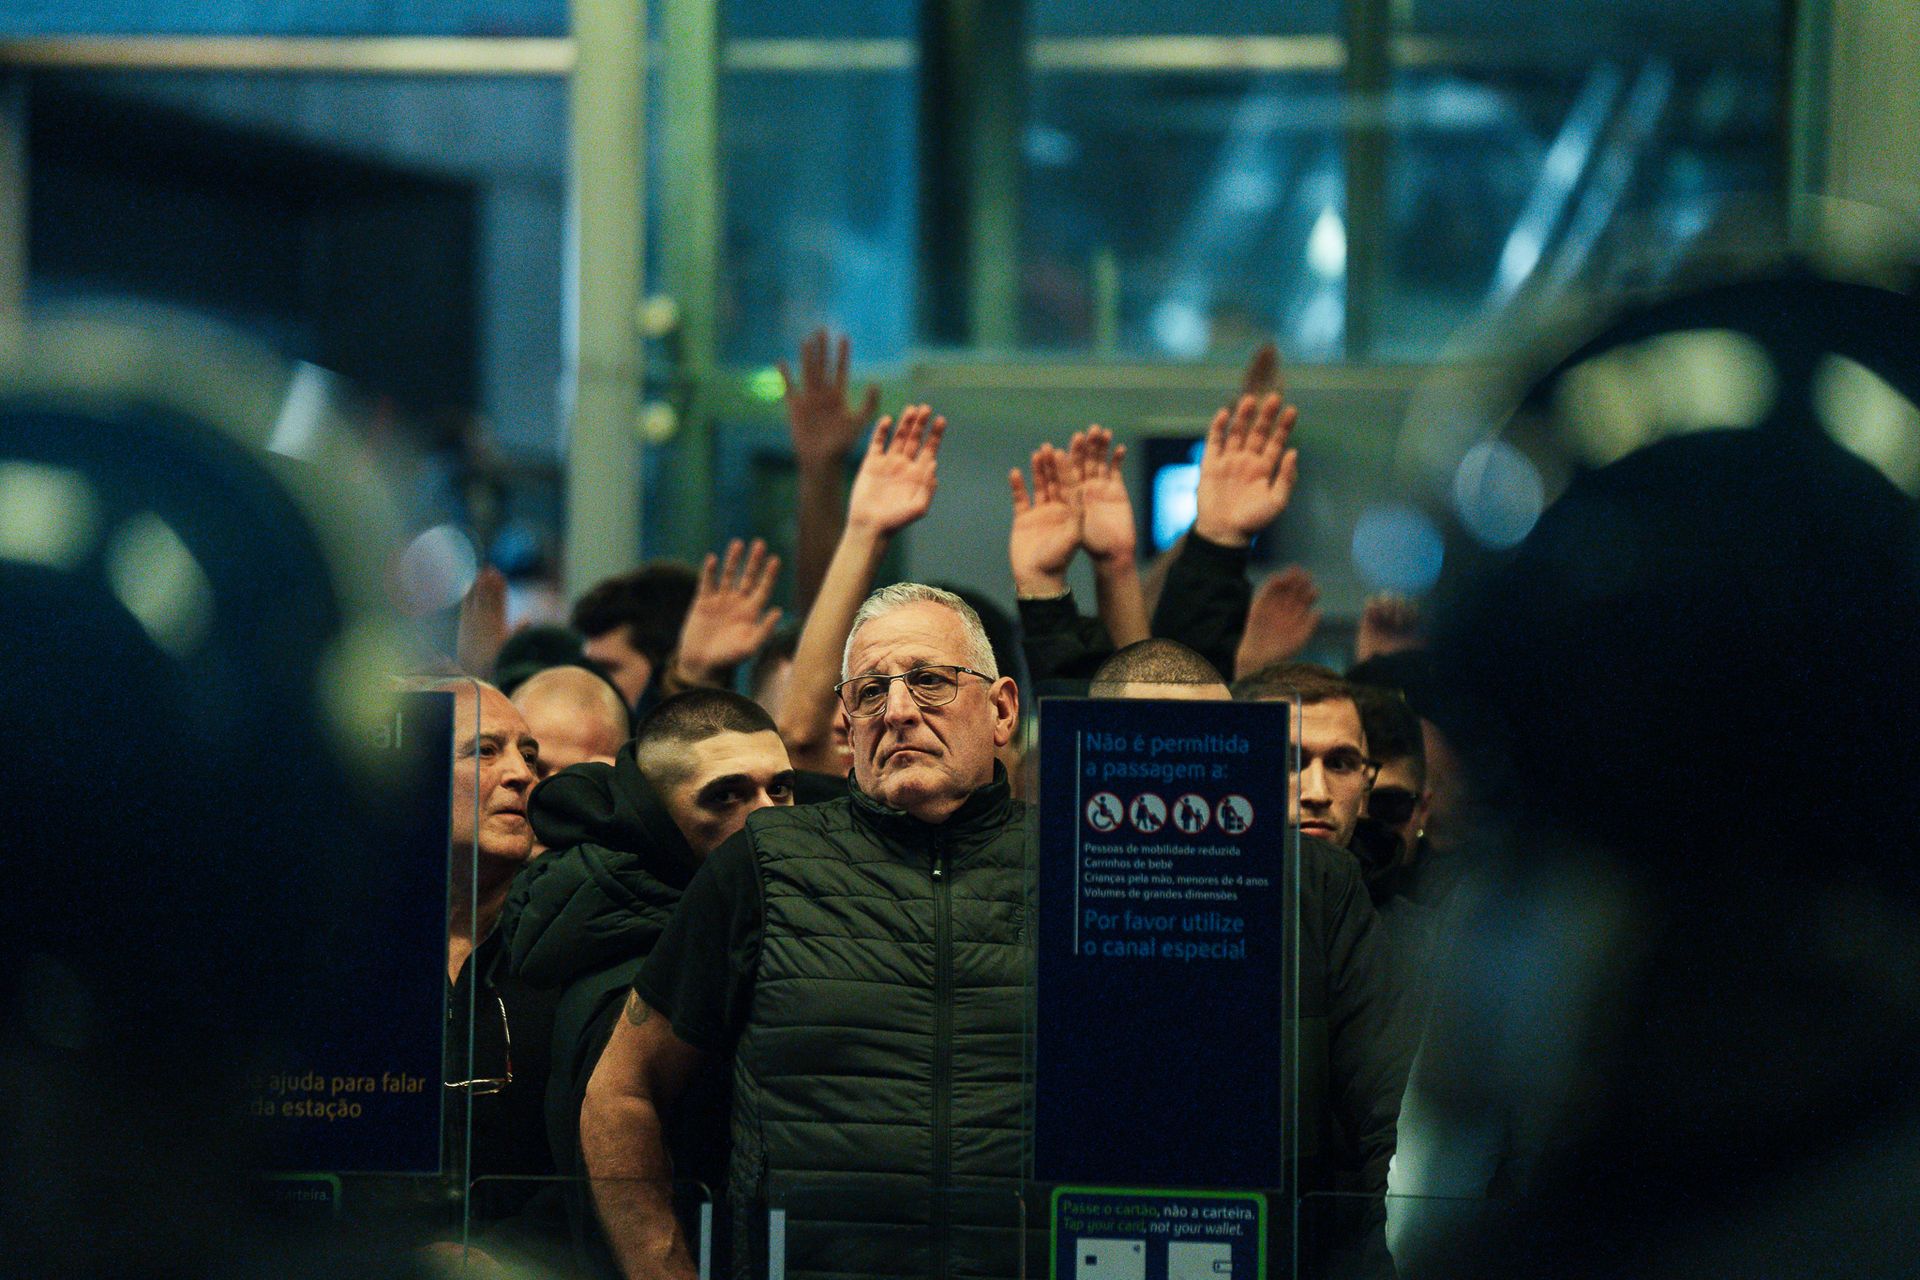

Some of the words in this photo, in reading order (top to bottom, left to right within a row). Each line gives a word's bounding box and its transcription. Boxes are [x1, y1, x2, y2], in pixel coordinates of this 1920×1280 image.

[1086, 732, 1127, 751] Não
[1133, 733, 1145, 752] é
[1150, 734, 1249, 757] permitida
[1086, 762, 1097, 777] a
[1102, 762, 1205, 784] passagem
[1212, 764, 1228, 779] a:
[1084, 843, 1124, 854] Pessoas
[1127, 844, 1139, 854] de
[1141, 845, 1196, 855] mobilidade
[1198, 846, 1241, 856] reduzida
[1084, 858, 1131, 868] Carrinhos
[1134, 859, 1146, 868] de
[1148, 860, 1173, 869] bebé
[1084, 872, 1125, 884] Crianças
[1128, 874, 1149, 886] pela
[1151, 874, 1175, 885] mão,
[1177, 877, 1219, 886] menores
[1221, 876, 1234, 886] de
[1236, 875, 1243, 885] 4
[1246, 878, 1269, 887] anos
[1084, 888, 1126, 898] Volumes
[1128, 889, 1141, 898] de
[1143, 889, 1183, 901] grandes
[1185, 890, 1238, 901] dimensões
[1084, 909, 1118, 930] Por
[1124, 910, 1176, 930] favor
[1182, 912, 1245, 932] utilize
[1084, 941, 1097, 956] o
[1103, 937, 1156, 957] canal
[1161, 938, 1245, 963] especial
[269, 1071, 325, 1095] ajuda
[331, 1075, 376, 1096] para
[382, 1071, 426, 1093] falar
[281, 1098, 363, 1122] estação
[1062, 1201, 1100, 1214] Passe
[1104, 1205, 1112, 1214] o
[1163, 1205, 1188, 1217] não
[1191, 1208, 1199, 1218] a
[1203, 1206, 1255, 1219] carteira.
[1064, 1218, 1084, 1231] Tap
[1087, 1221, 1115, 1233] your
[1150, 1222, 1170, 1232] not
[1174, 1224, 1203, 1237] your
[1206, 1224, 1244, 1236] wallet.
